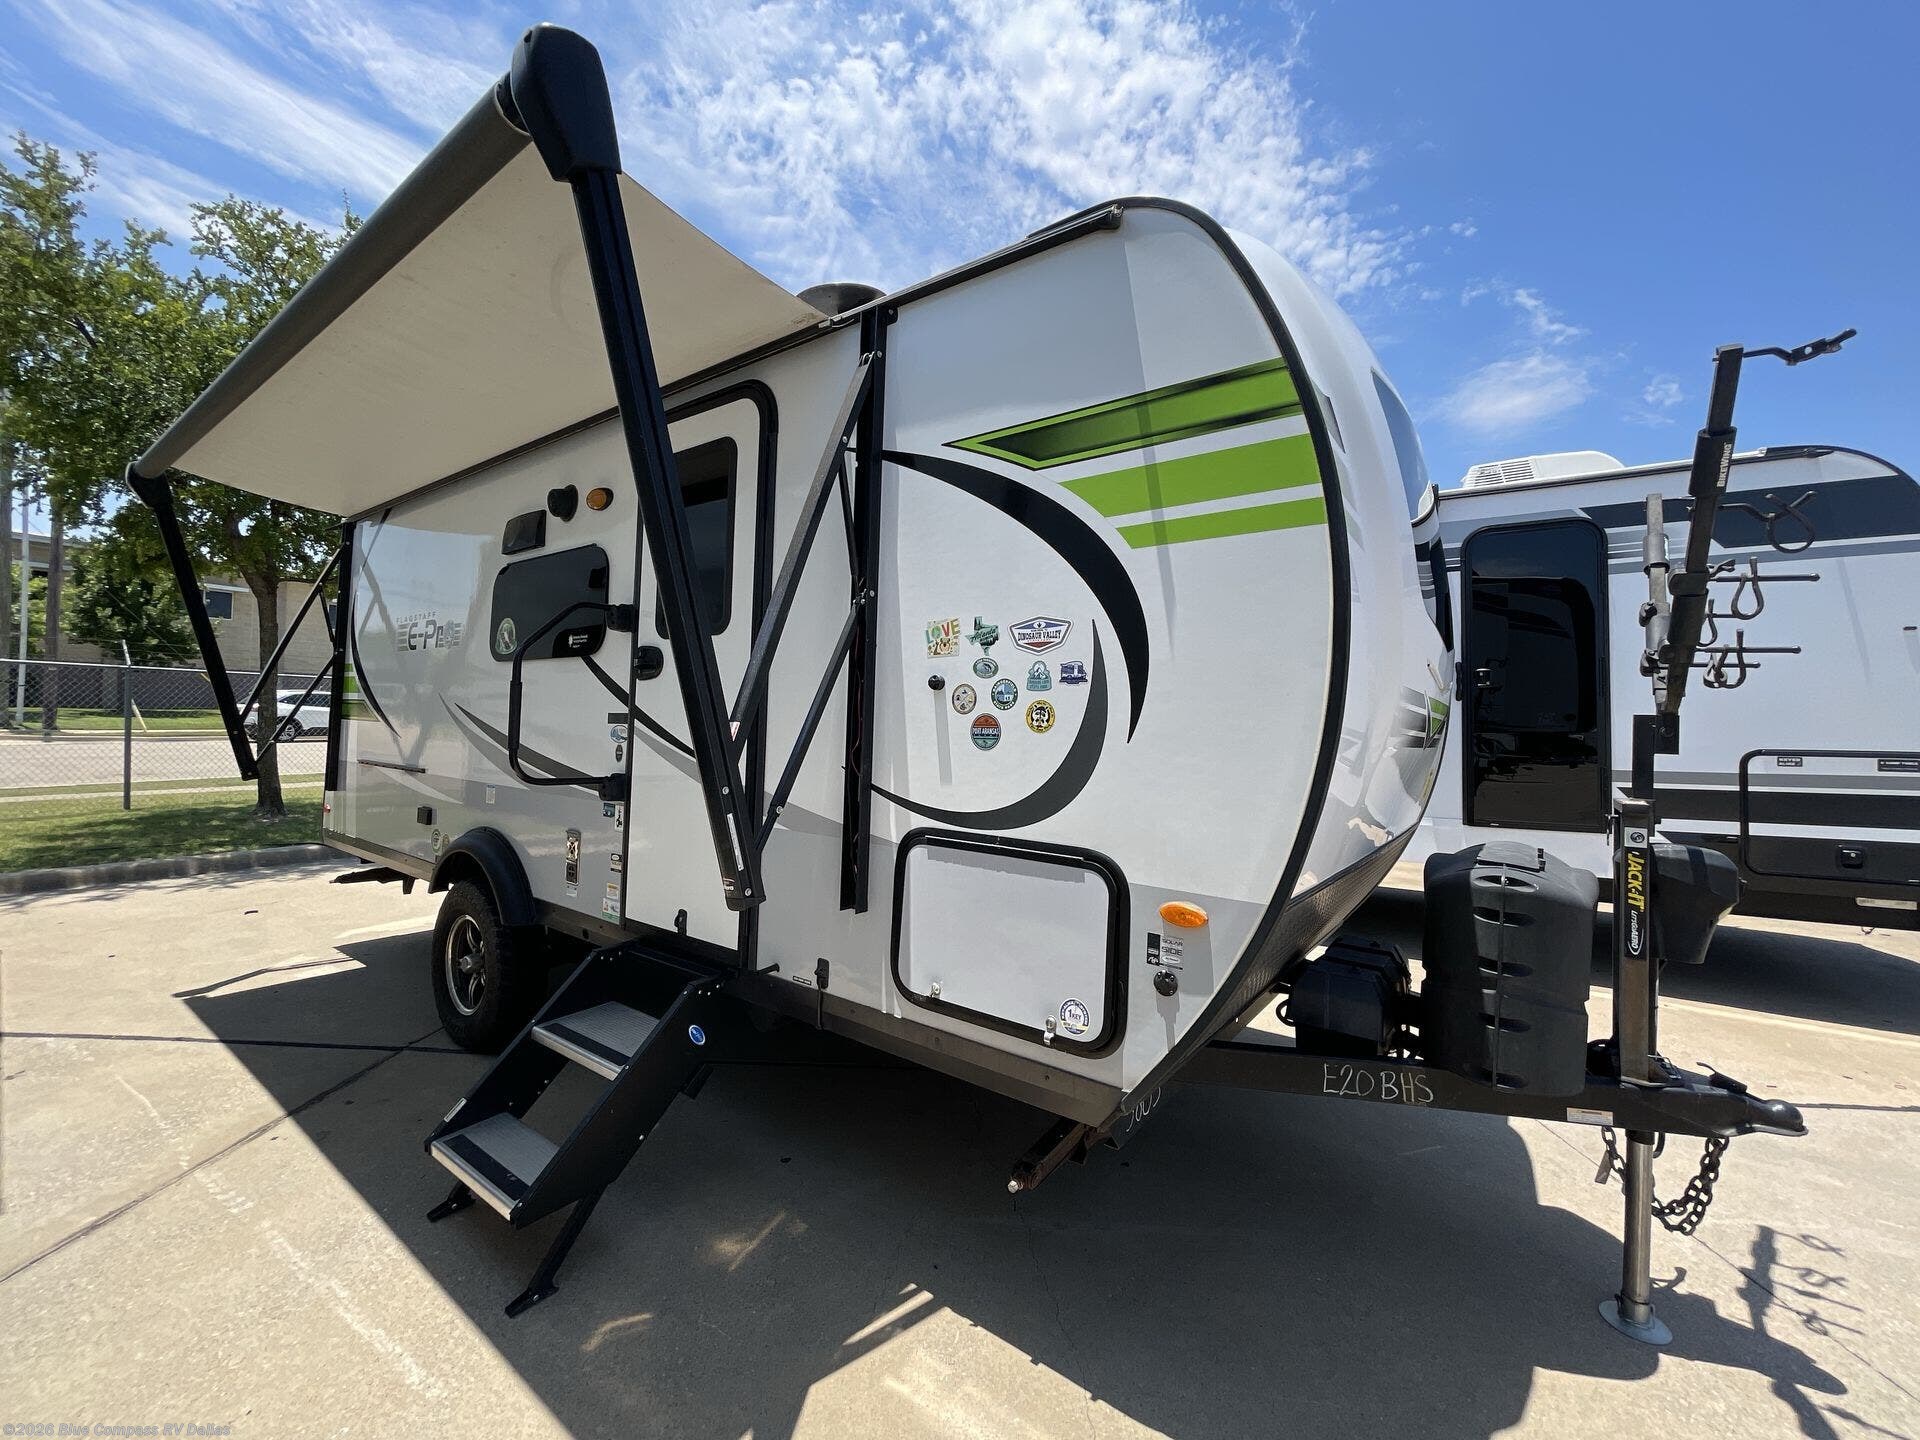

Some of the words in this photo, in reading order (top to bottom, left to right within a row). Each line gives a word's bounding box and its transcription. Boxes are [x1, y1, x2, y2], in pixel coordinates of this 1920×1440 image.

[396, 611, 436, 623] FLAGSTAFF
[925, 618, 961, 644] LOVE
[1017, 632, 1042, 641] DINOSAUR
[1042, 630, 1061, 639] VALLEY
[1162, 937, 1183, 946] SOLAR
[1161, 946, 1183, 956] SIDE
